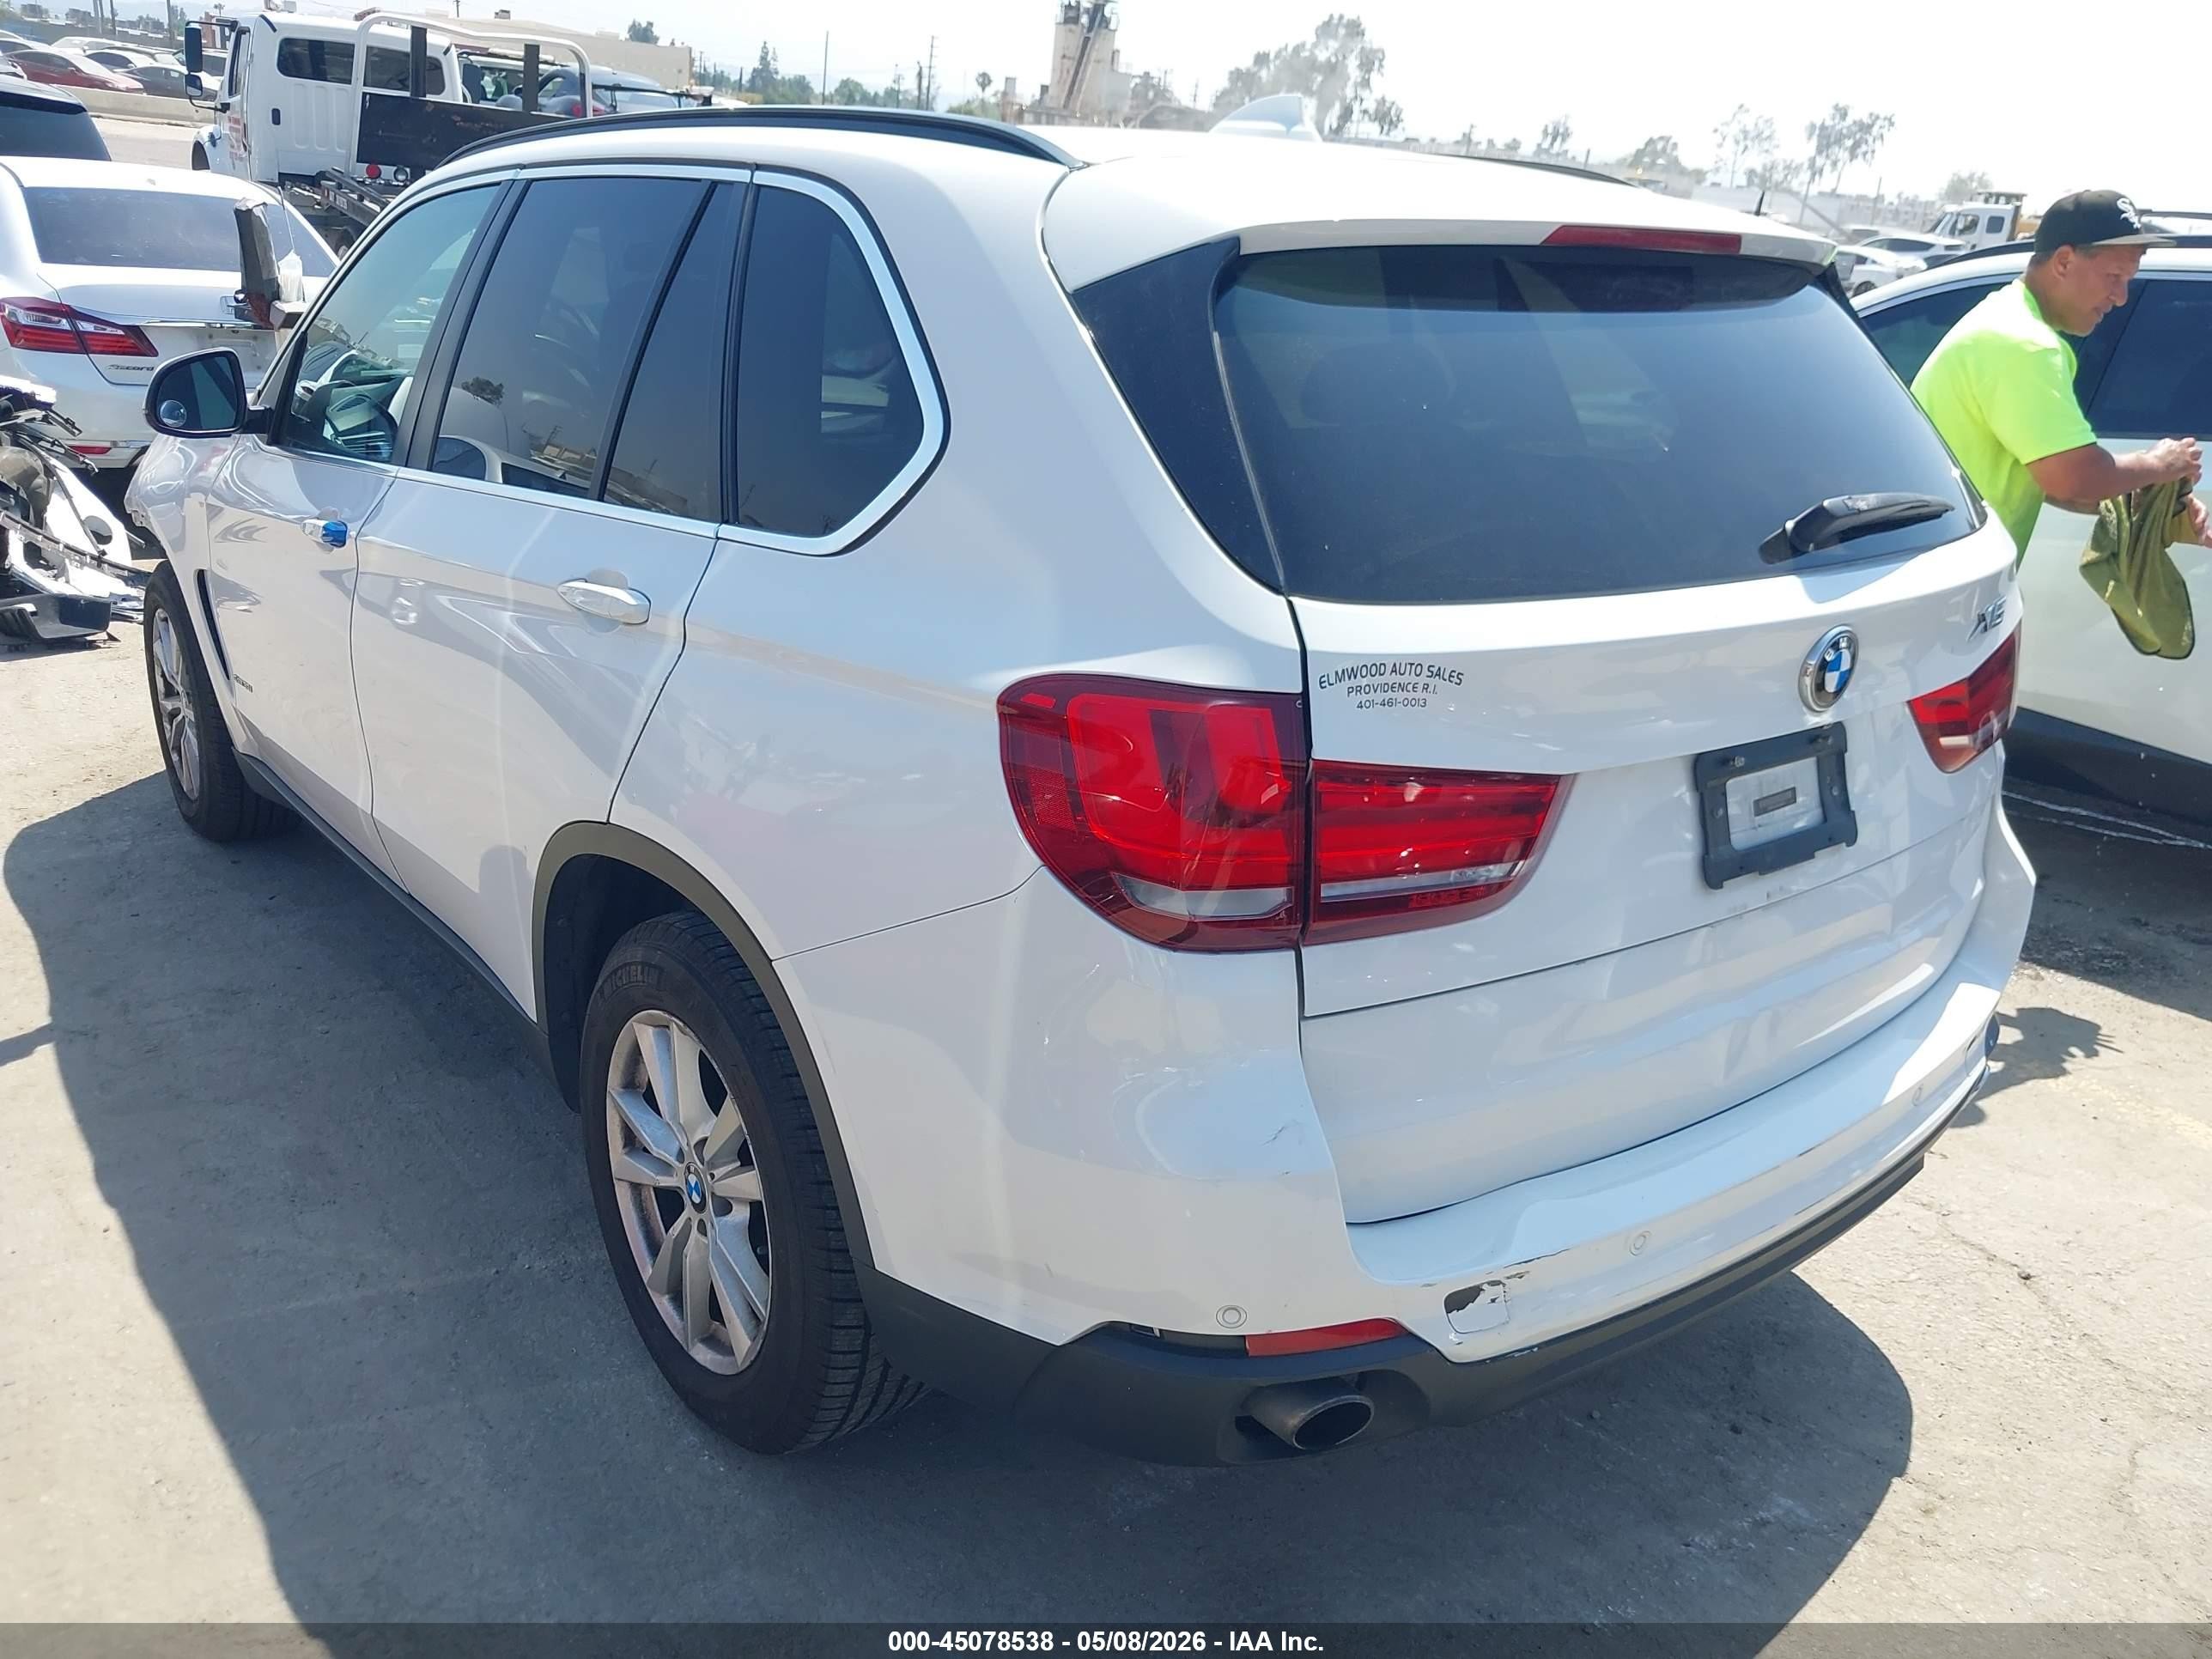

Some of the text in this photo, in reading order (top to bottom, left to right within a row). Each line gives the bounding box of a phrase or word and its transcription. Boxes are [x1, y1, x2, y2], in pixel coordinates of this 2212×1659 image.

[1319, 662, 1464, 690] ELMWOOD AUTO SALES
[1347, 682, 1437, 697] PROVIDENCE R.I.
[1357, 697, 1427, 709] 401-461-0013
